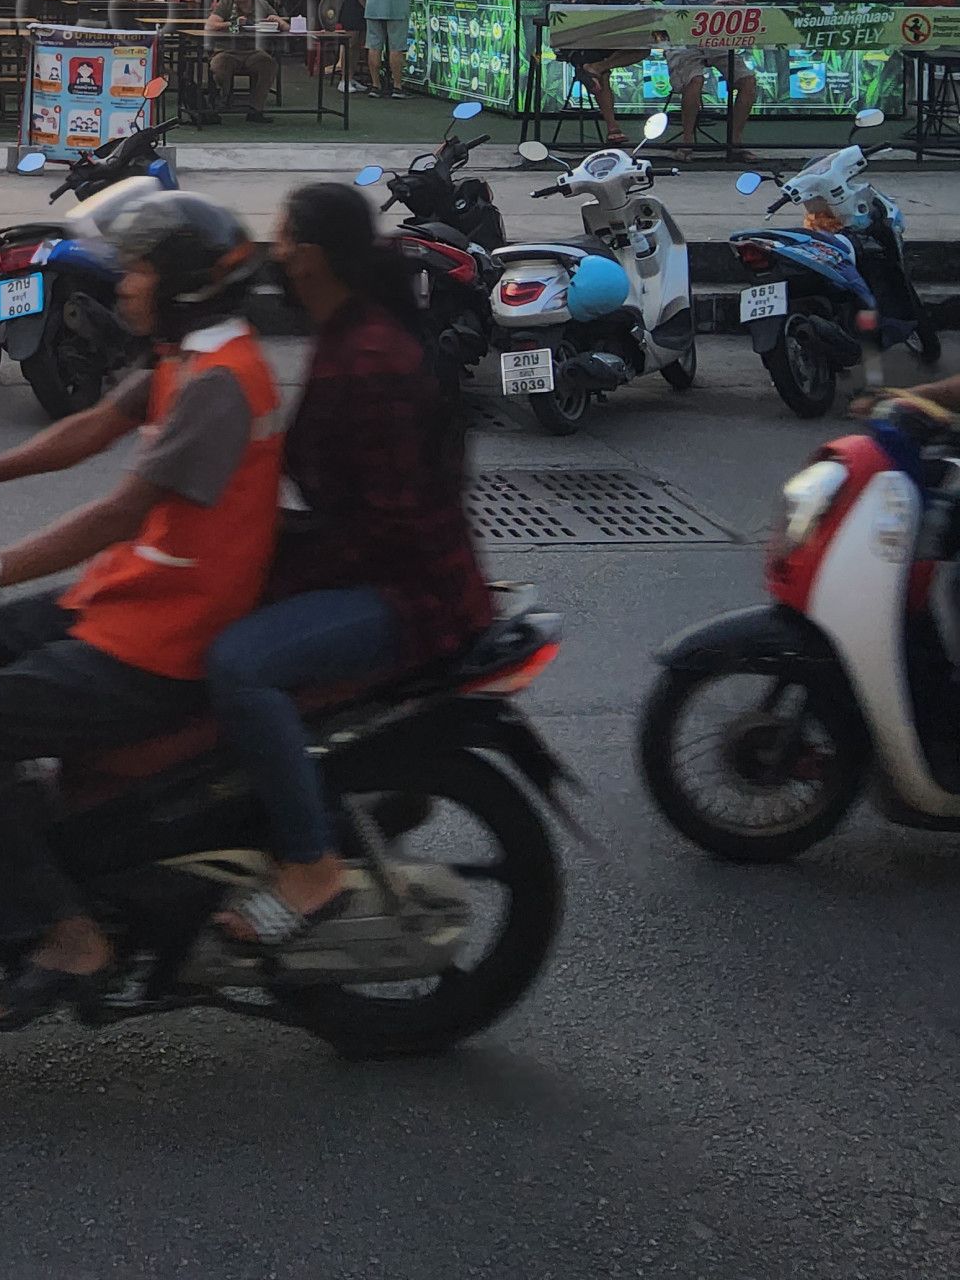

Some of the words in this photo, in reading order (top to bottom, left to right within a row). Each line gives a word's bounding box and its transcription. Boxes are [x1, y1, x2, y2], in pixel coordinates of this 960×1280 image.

[691, 8, 767, 37] 300B.
[698, 36, 756, 48] LEGALIZED
[855, 28, 885, 45] FLY
[8, 303, 31, 316] 800
[750, 305, 775, 317] 437
[512, 379, 545, 393] 3039
